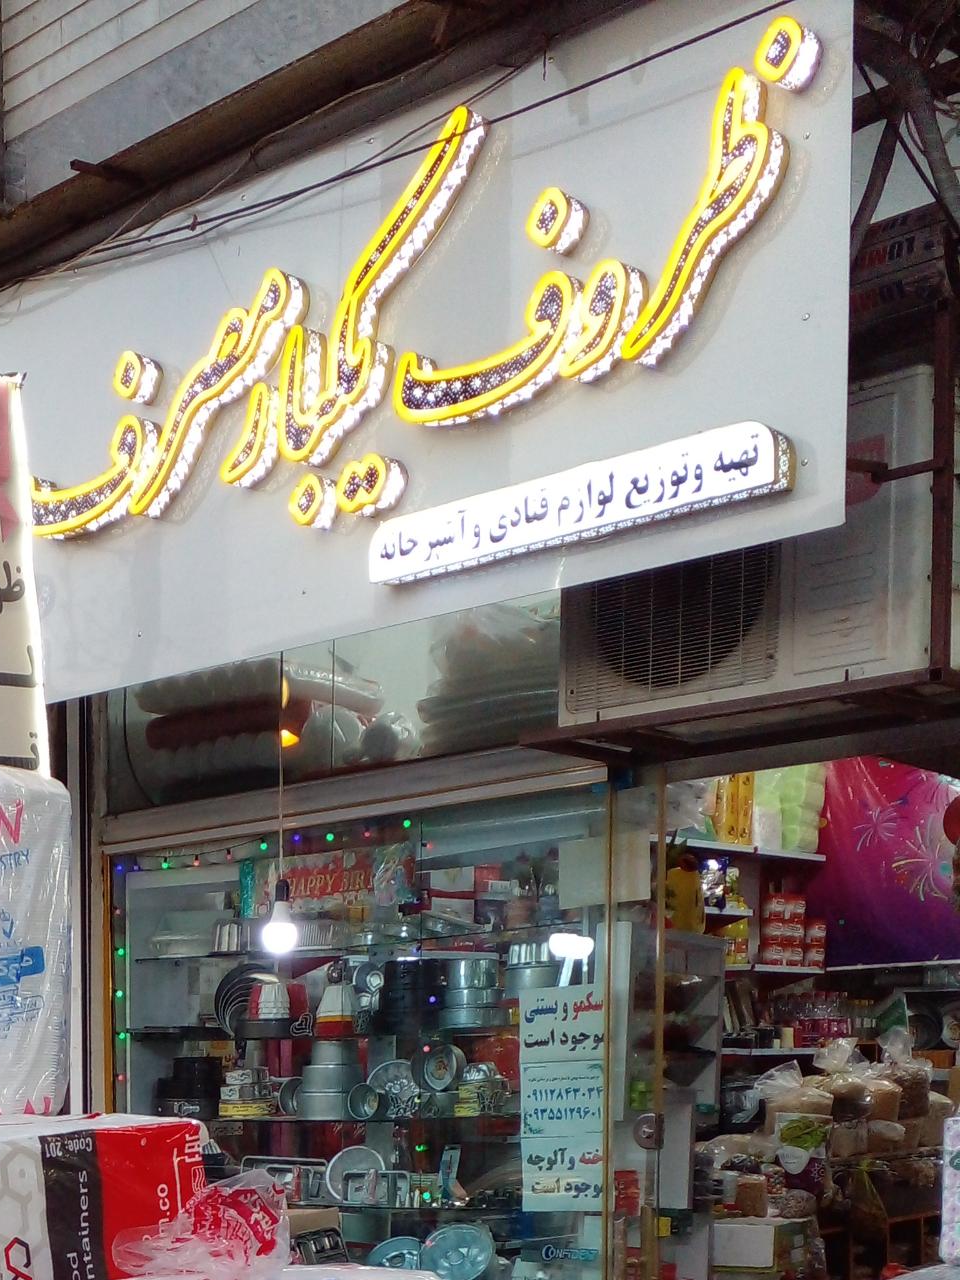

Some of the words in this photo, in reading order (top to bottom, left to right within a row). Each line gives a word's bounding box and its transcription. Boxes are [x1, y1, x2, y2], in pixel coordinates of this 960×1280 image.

[395, 16, 823, 428] ظروف
[220, 105, 490, 531] یکبار
[30, 268, 309, 541] مصرف
[713, 433, 760, 482] تهیه
[488, 487, 550, 543] قنادی
[556, 470, 615, 526] لوازم
[524, 997, 559, 1024] بستنی
[561, 1001, 569, 1022] و
[523, 1027, 556, 1049] است
[526, 1147, 568, 1172] آلوچه
[578, 1148, 604, 1165] خته
[531, 1177, 561, 1195] است
